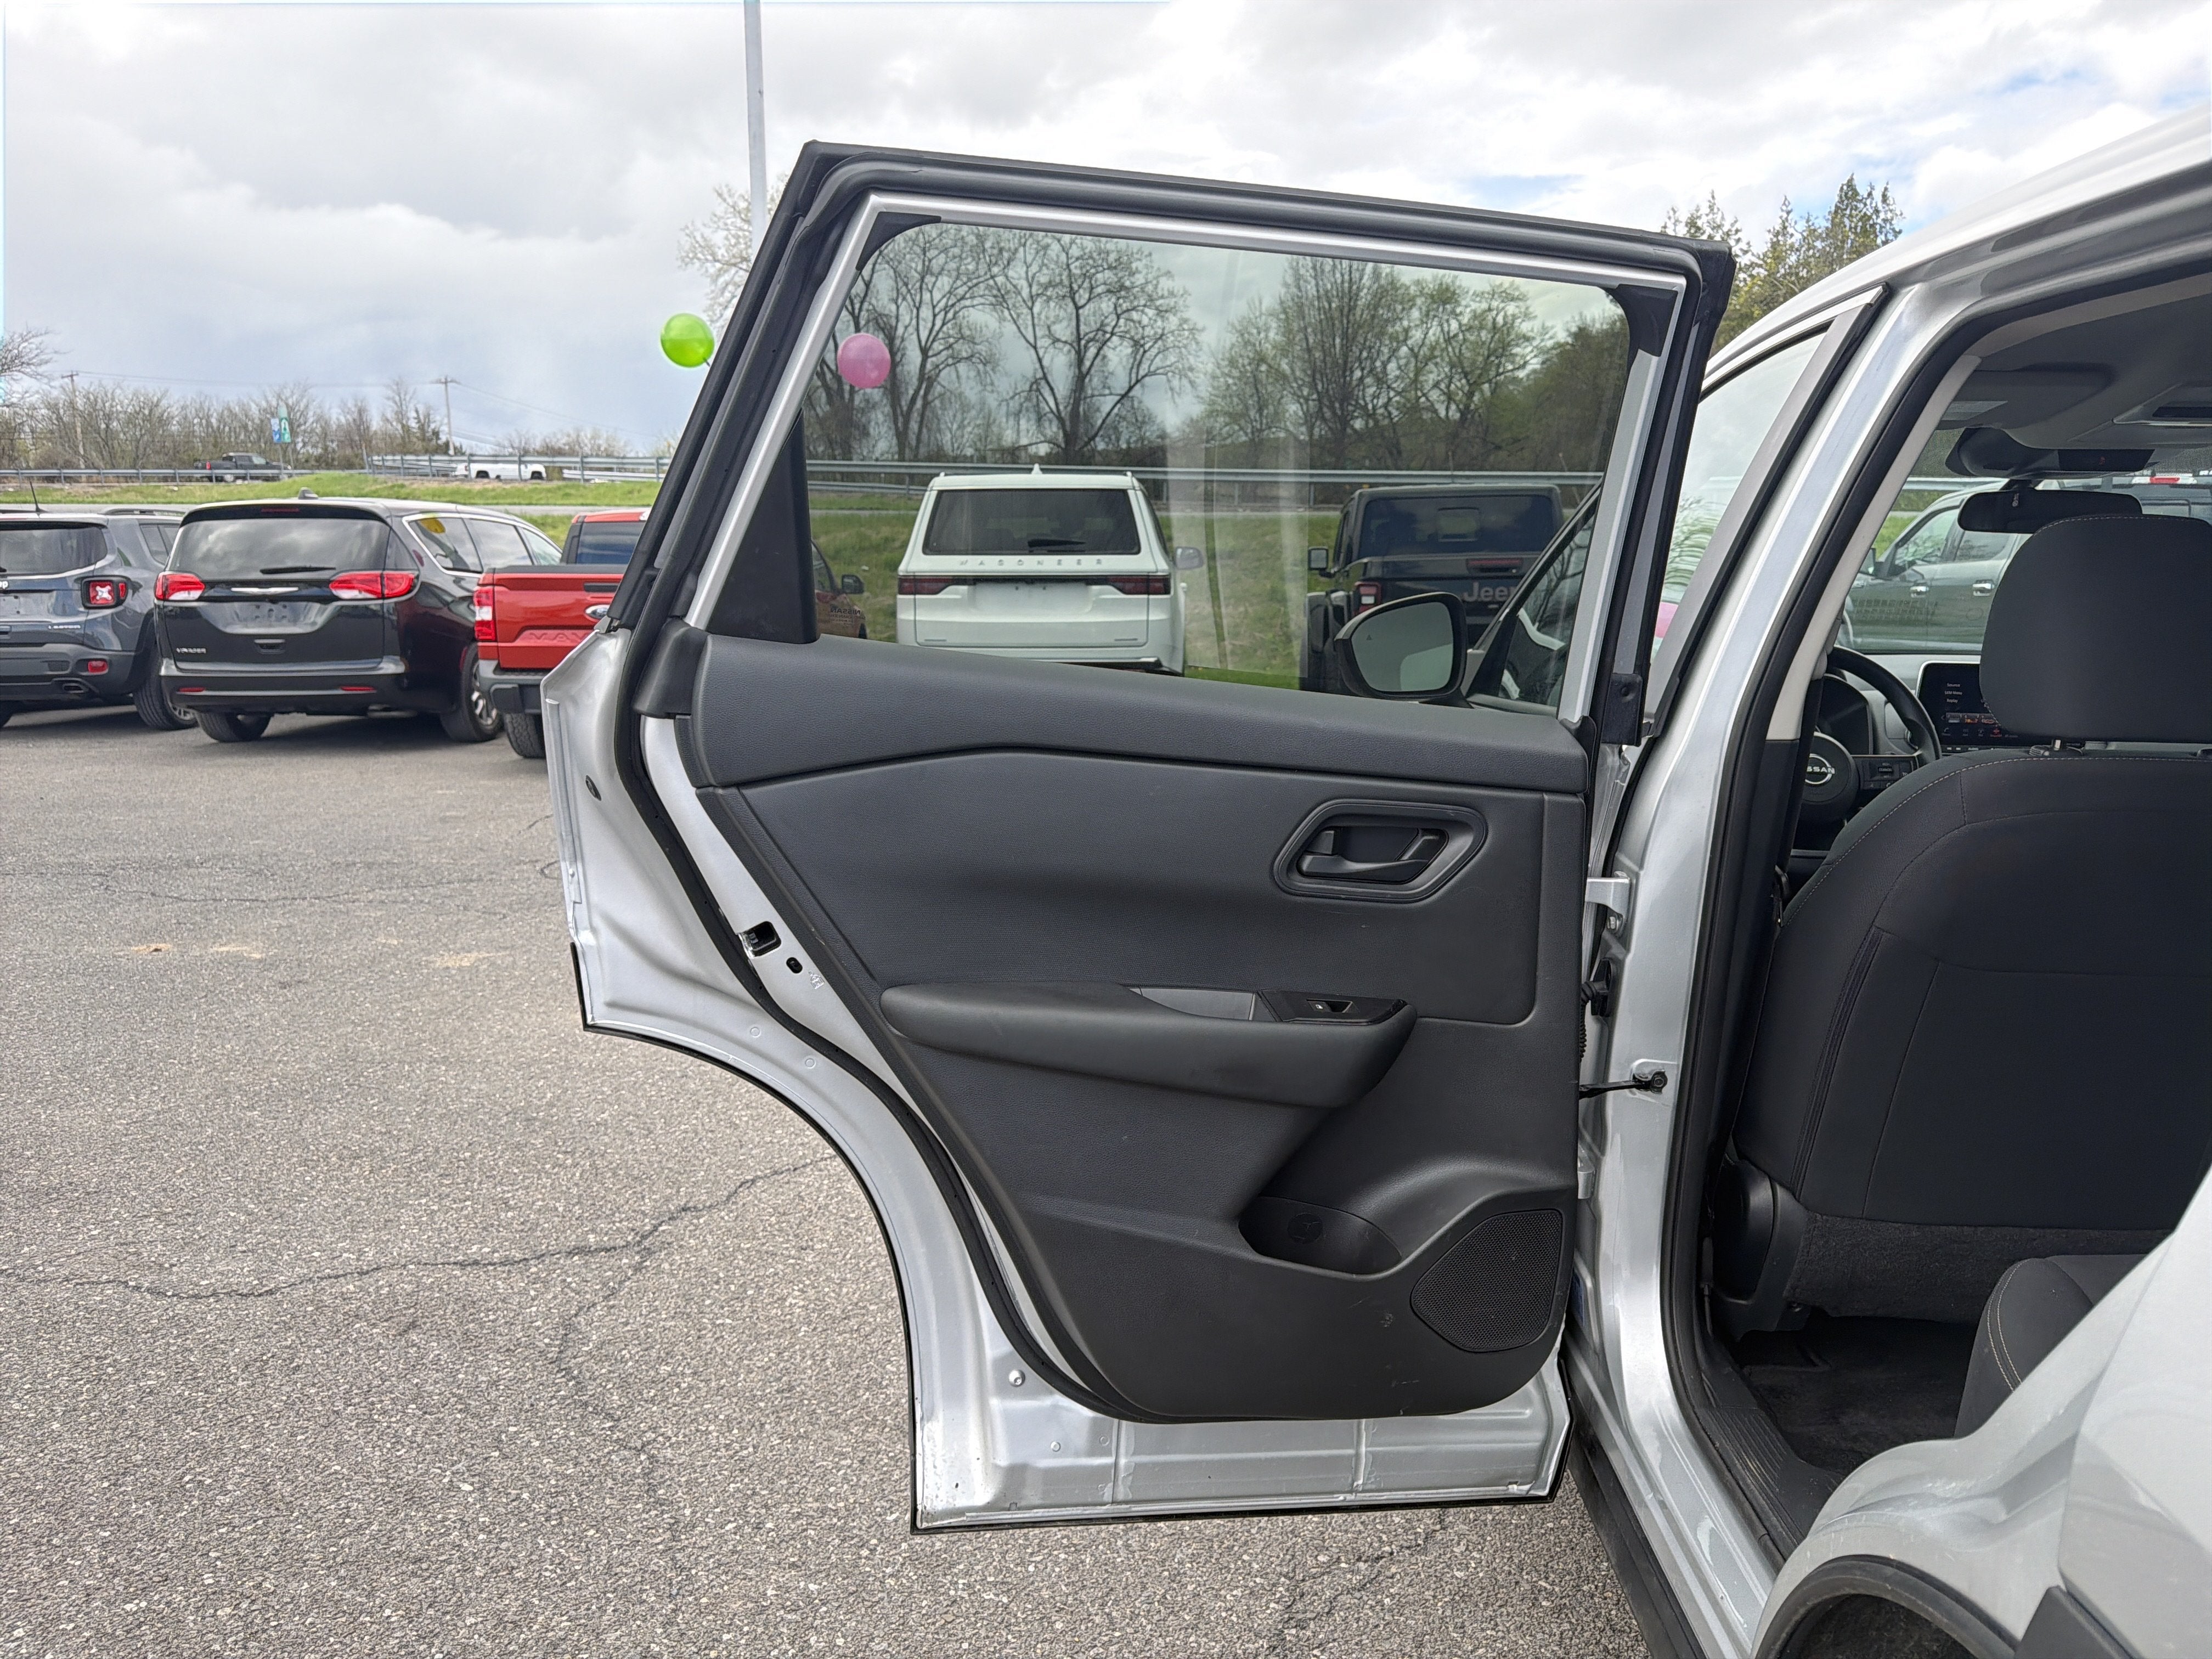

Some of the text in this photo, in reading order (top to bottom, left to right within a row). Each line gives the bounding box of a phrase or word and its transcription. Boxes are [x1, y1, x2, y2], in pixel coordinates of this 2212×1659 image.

[959, 558, 1103, 566] WAGONEER
[529, 632, 589, 641] MAV
[1807, 766, 1835, 774] SSAN
